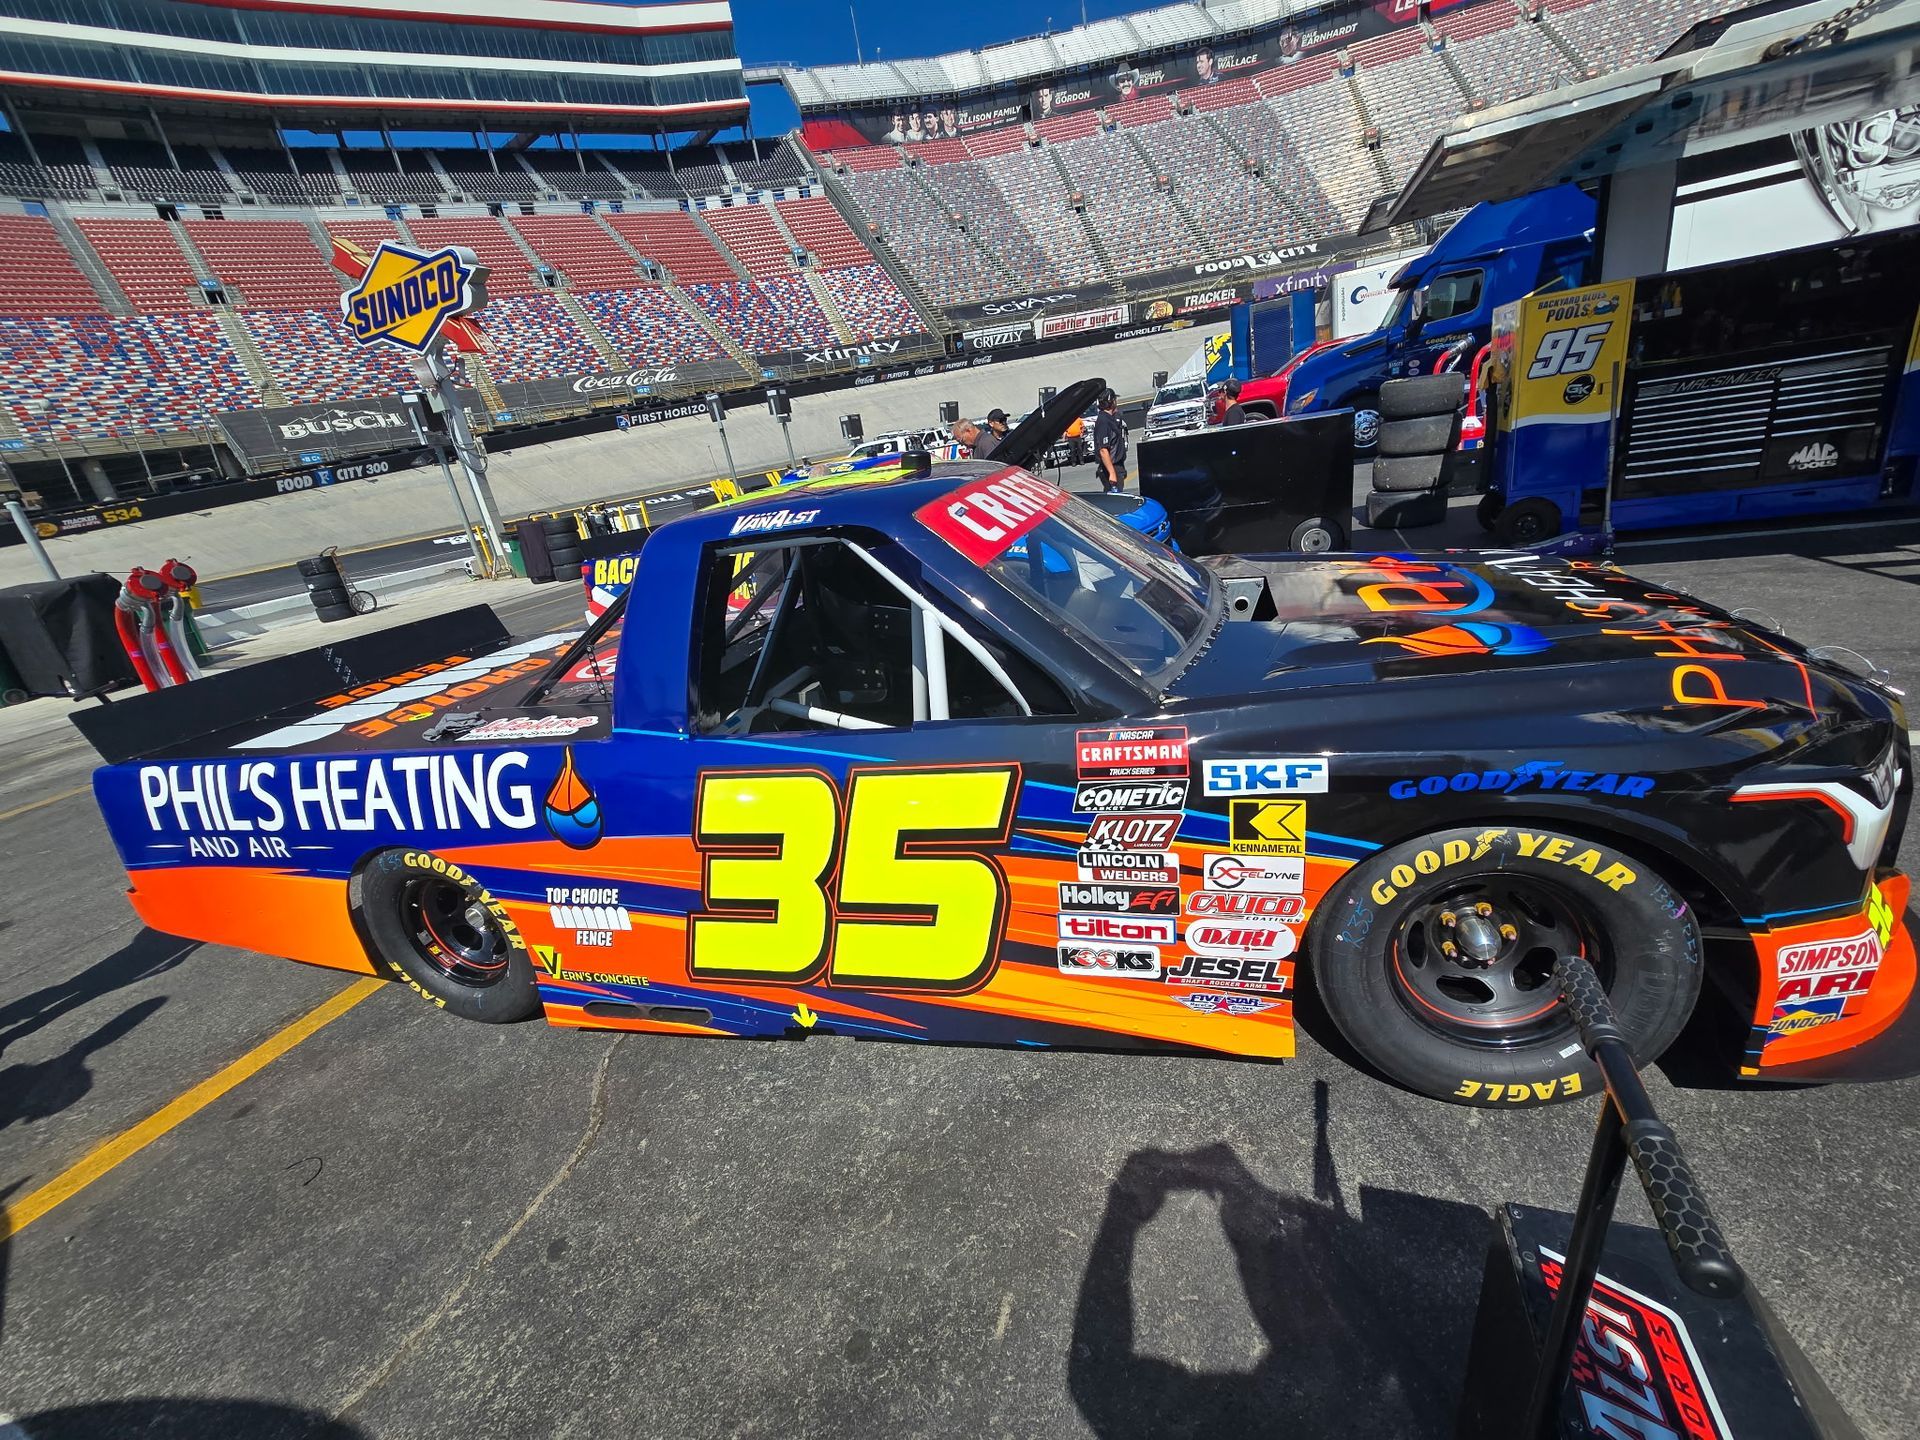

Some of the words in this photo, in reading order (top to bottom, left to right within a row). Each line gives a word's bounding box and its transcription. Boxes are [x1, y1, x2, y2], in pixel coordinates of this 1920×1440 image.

[1301, 23, 1358, 48] EARNHARDT
[1217, 54, 1258, 70] WALLACE
[1138, 74, 1166, 87] PETTY
[1055, 90, 1091, 105] GORDON
[958, 111, 992, 125] ALLISON
[993, 105, 1022, 118] FAMILY
[1194, 258, 1245, 275] FOOD
[1277, 243, 1318, 259] CITY
[353, 259, 460, 335] SUNOCO
[1184, 288, 1237, 307] TRACKER
[1538, 295, 1580, 309] BACKYARD
[1582, 291, 1607, 300] BLUES
[1045, 317, 1087, 334] weather
[1089, 310, 1120, 327] guard
[1545, 303, 1591, 323] POOLS
[973, 330, 1024, 349] GRIZZLY
[1115, 325, 1162, 340] CHEVROLET
[804, 339, 901, 364] xfinity
[1527, 320, 1614, 380] 95
[573, 366, 679, 393] Coca-Cola
[1677, 367, 1782, 393] MACSIMIZER
[631, 411, 662, 425] FIRST
[664, 403, 709, 420] HORIZO
[278, 411, 408, 440] BUSCH
[1788, 442, 1839, 464] MAC
[1790, 459, 1837, 470] TOOLS
[276, 475, 313, 493] FOOD
[336, 465, 363, 481] CITY
[366, 461, 389, 475] 300
[62, 514, 97, 526] TRACKER
[102, 506, 142, 523] 534
[1117, 730, 1154, 741] NASCAR
[1081, 744, 1183, 762] CRAFTSMAN
[1109, 767, 1132, 776] TRUCK
[1132, 767, 1155, 775] SERIES
[1209, 764, 1323, 791] SKF
[1389, 760, 1656, 800] GOODYEAR
[140, 761, 288, 833] PHIL'S
[290, 751, 537, 832] HEATING
[1078, 783, 1185, 807] COMETIC
[1095, 819, 1175, 842] KLOTZ
[190, 836, 239, 858] AND
[249, 836, 293, 859] AIR
[1233, 843, 1302, 854] KENNAMETAL
[1082, 853, 1160, 868] LINCOLN
[688, 764, 1020, 994] 35
[1100, 869, 1169, 882] WELDERS
[1207, 867, 1301, 881] XCELDYNE
[546, 888, 570, 904] TOP
[571, 888, 619, 905] CHOICE
[1061, 885, 1130, 911] Holley
[1131, 890, 1176, 911] EFI
[1188, 894, 1304, 916] CALICO
[576, 930, 614, 947] FENCE
[1065, 918, 1168, 941] tilton
[1197, 927, 1286, 949] DART
[1060, 947, 1155, 971] KOOKS
[1781, 936, 1879, 974] SIMPSON
[593, 972, 650, 987] CONCRETE
[1169, 957, 1283, 984] JESEL
[388, 961, 447, 1009] EAGLE
[1190, 994, 1221, 1003] FIVE
[1227, 996, 1261, 1007] STAR
[1766, 1012, 1837, 1032] SUNOCO
[1455, 1072, 1583, 1102] EAGLE
